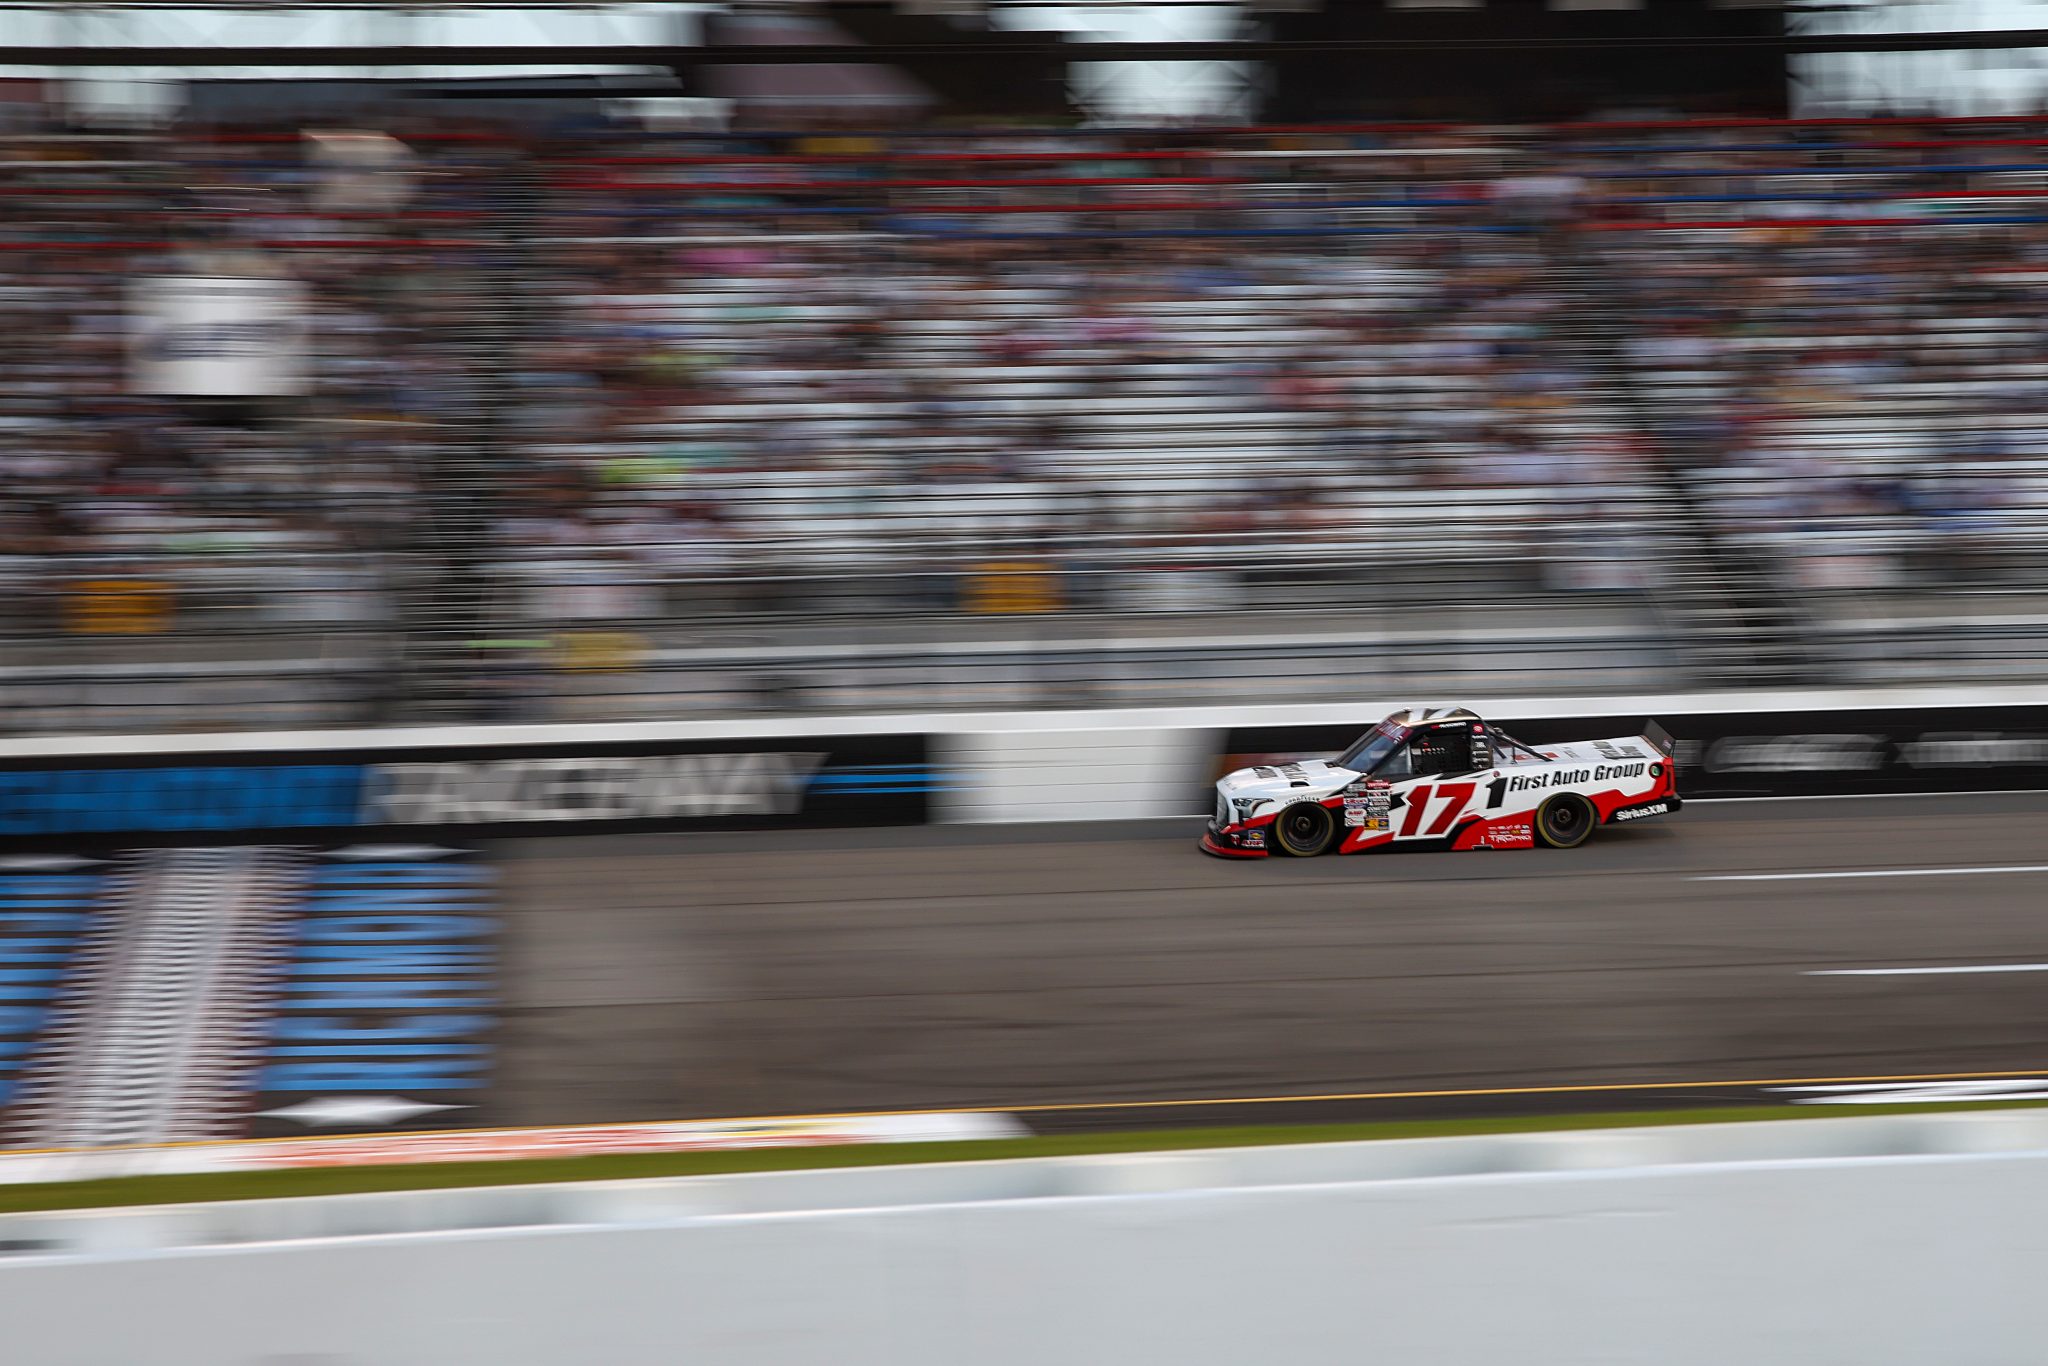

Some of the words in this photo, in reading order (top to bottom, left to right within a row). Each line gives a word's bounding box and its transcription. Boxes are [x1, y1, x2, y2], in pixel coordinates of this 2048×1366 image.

[1509, 773, 1549, 792] First
[1551, 768, 1590, 786] Auto
[1594, 762, 1645, 781] Group
[1399, 782, 1477, 837] 17
[1616, 803, 1668, 821] SiriusXM
